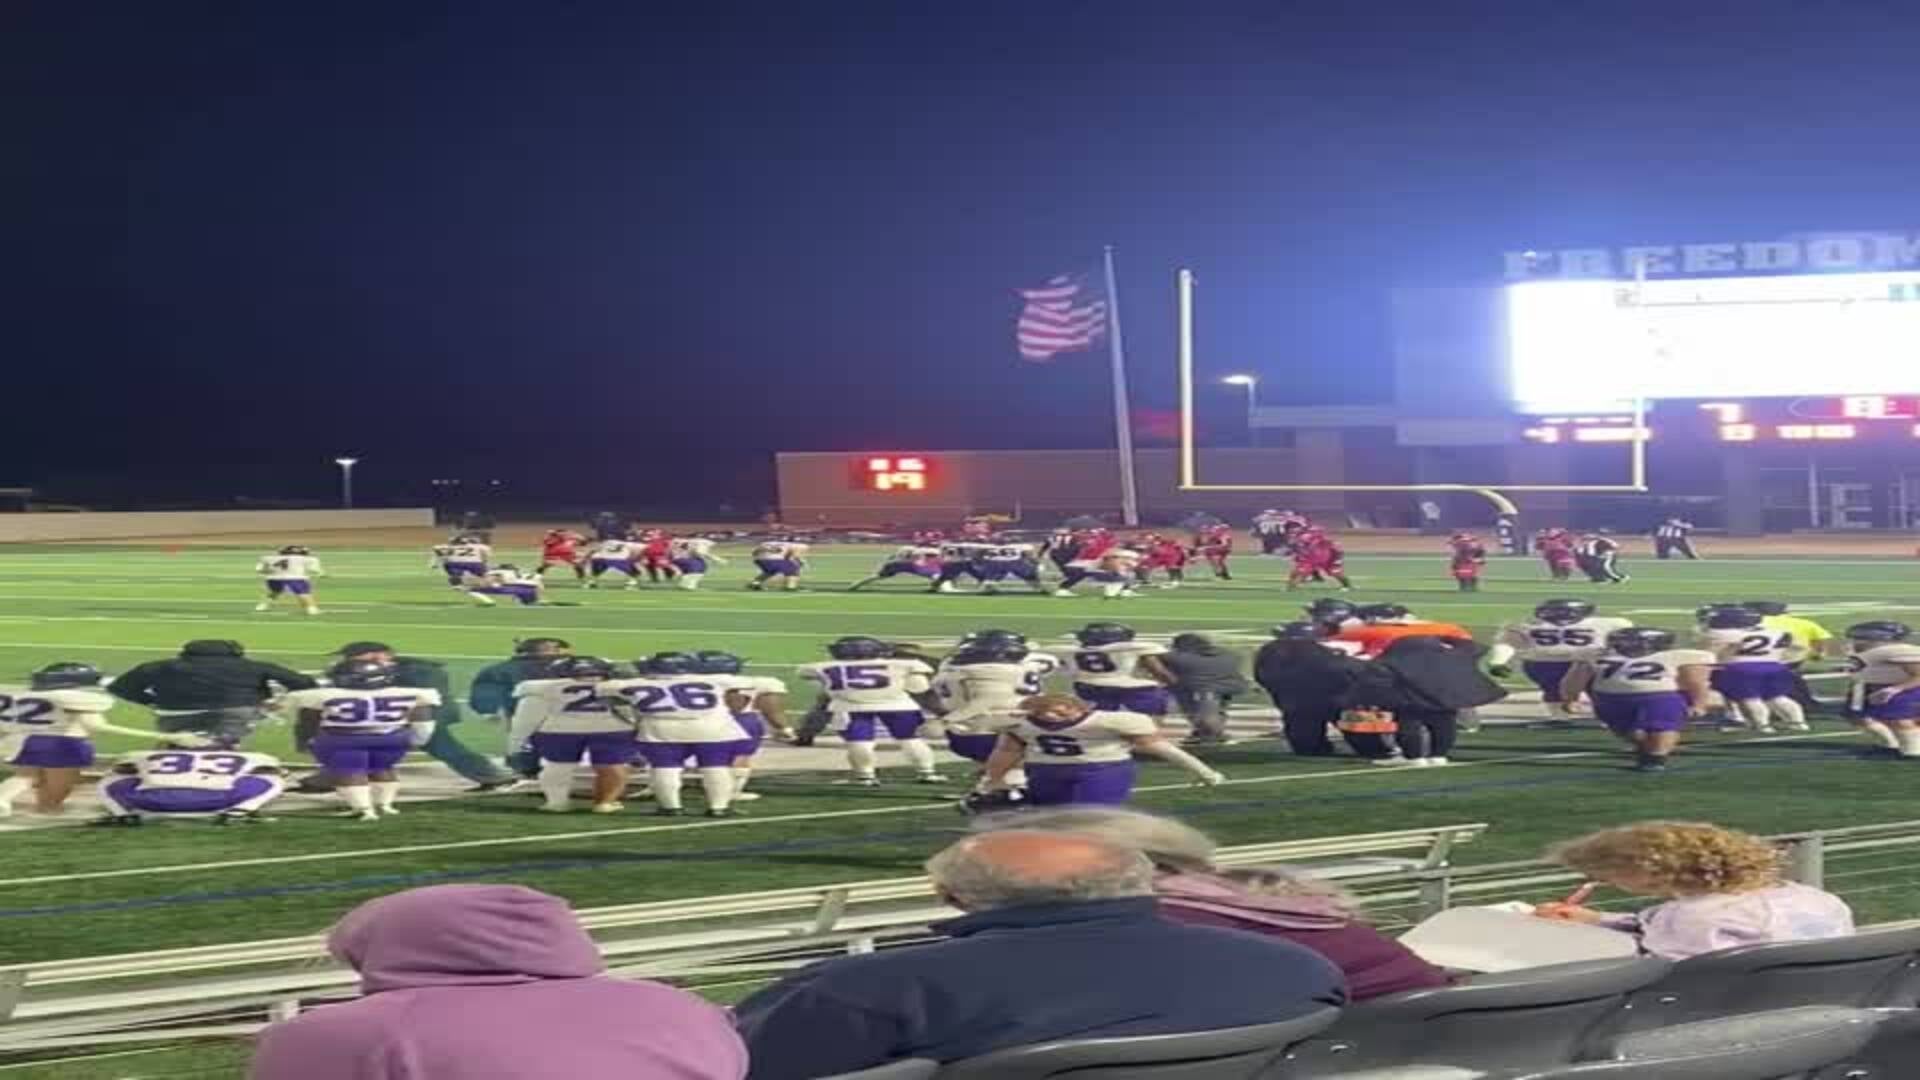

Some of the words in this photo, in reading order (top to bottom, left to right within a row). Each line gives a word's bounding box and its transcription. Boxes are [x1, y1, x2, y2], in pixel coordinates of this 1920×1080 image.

[1530, 628, 1595, 647] 55
[821, 664, 889, 692] 15
[320, 696, 417, 724] 35
[620, 682, 718, 713] 26
[147, 753, 248, 775] 33
